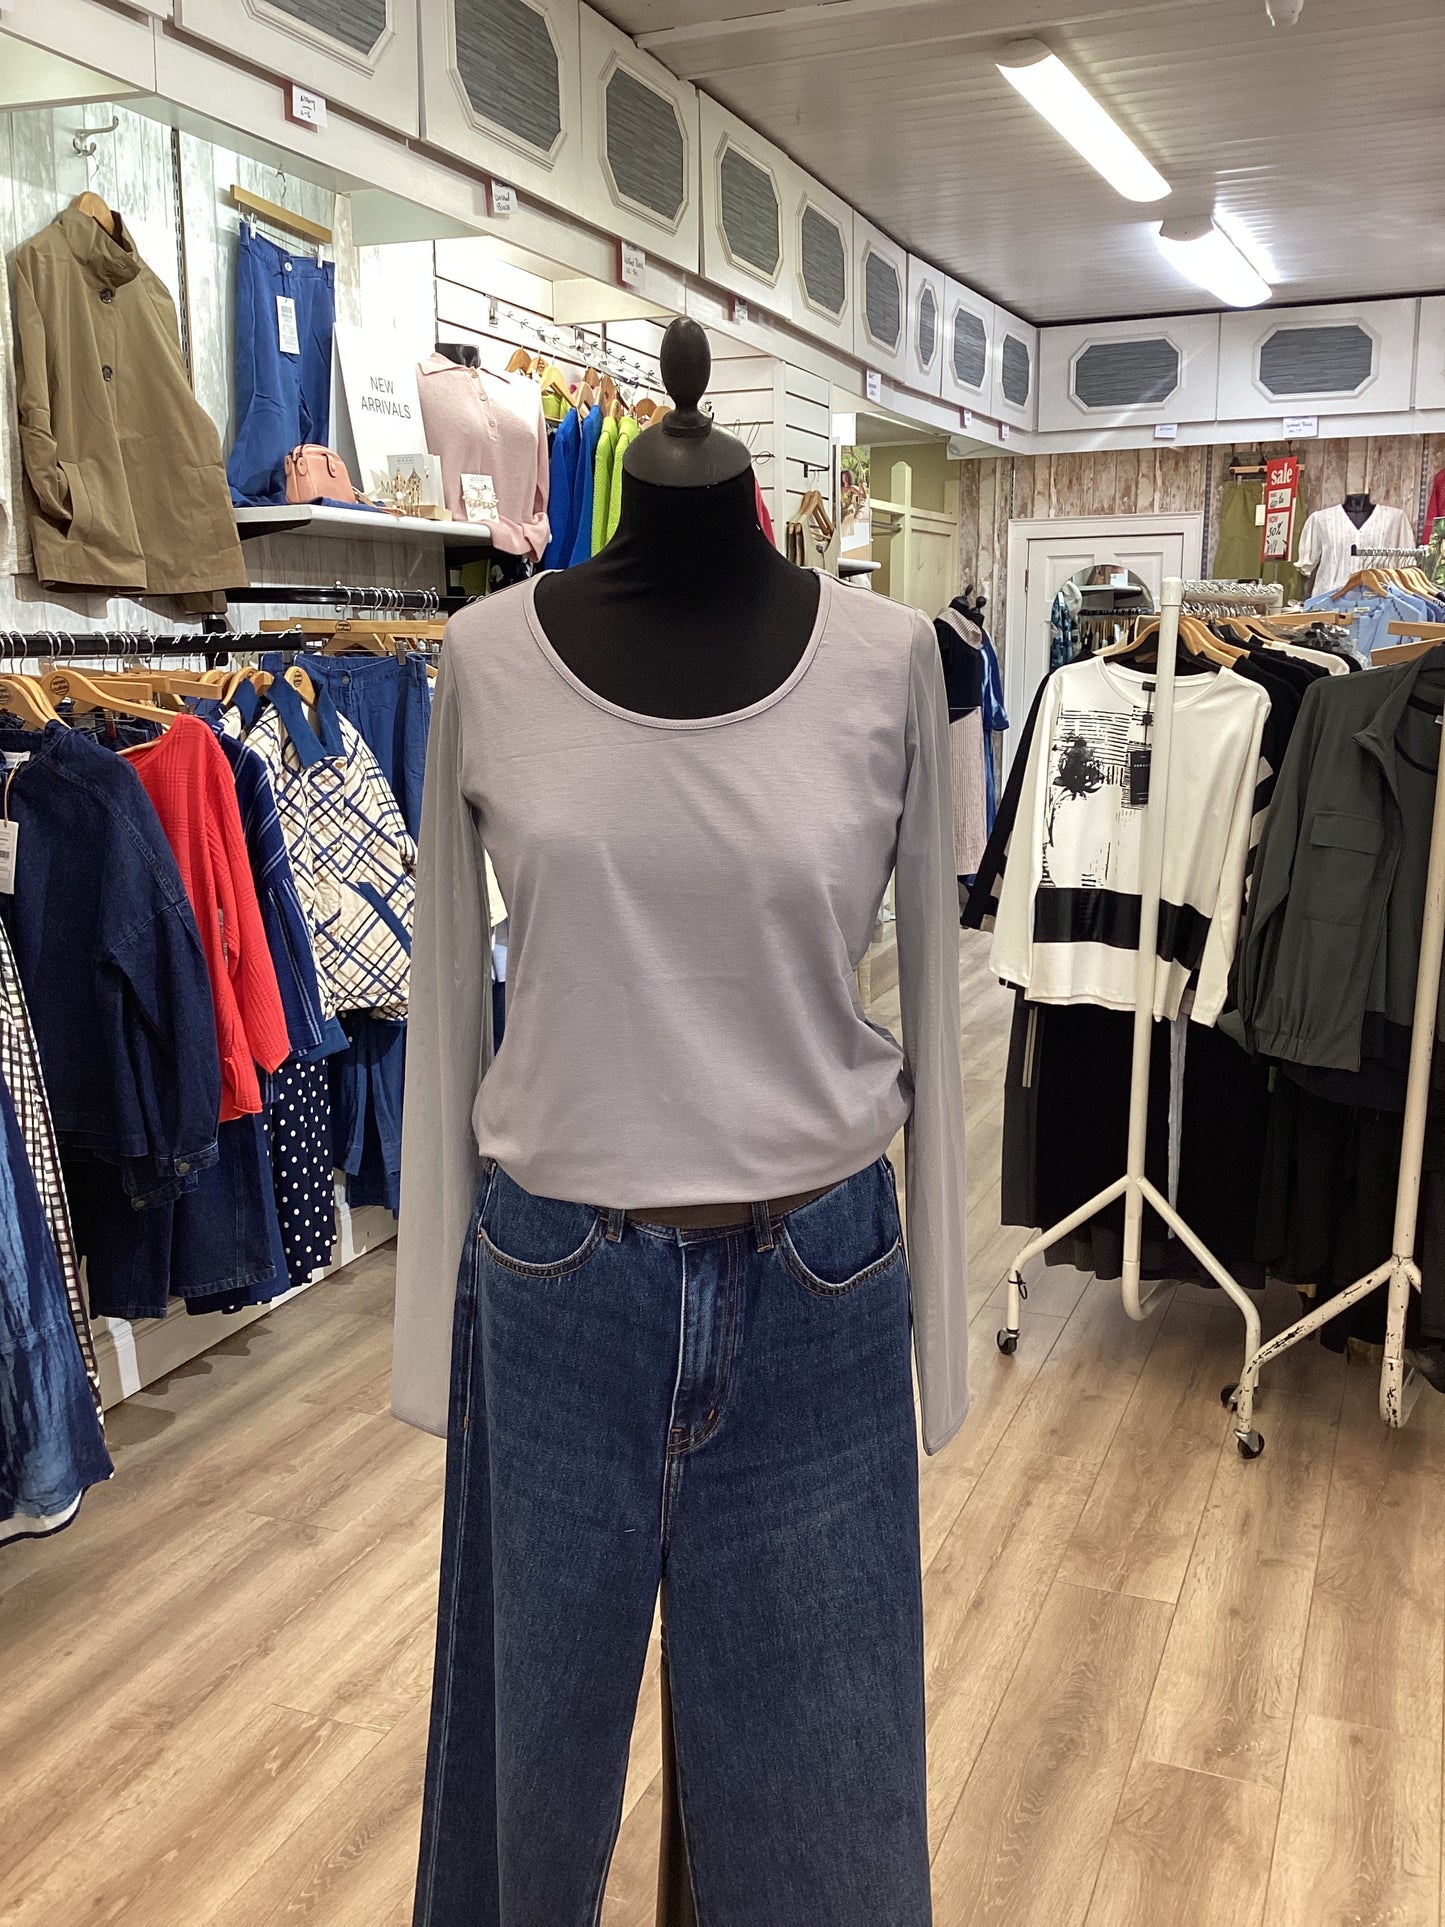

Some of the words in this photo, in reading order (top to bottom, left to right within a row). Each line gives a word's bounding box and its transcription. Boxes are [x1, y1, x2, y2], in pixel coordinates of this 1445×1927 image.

[370, 376, 393, 395] NEW
[362, 396, 411, 419] ARRIVALS
[1271, 462, 1292, 485] sale
